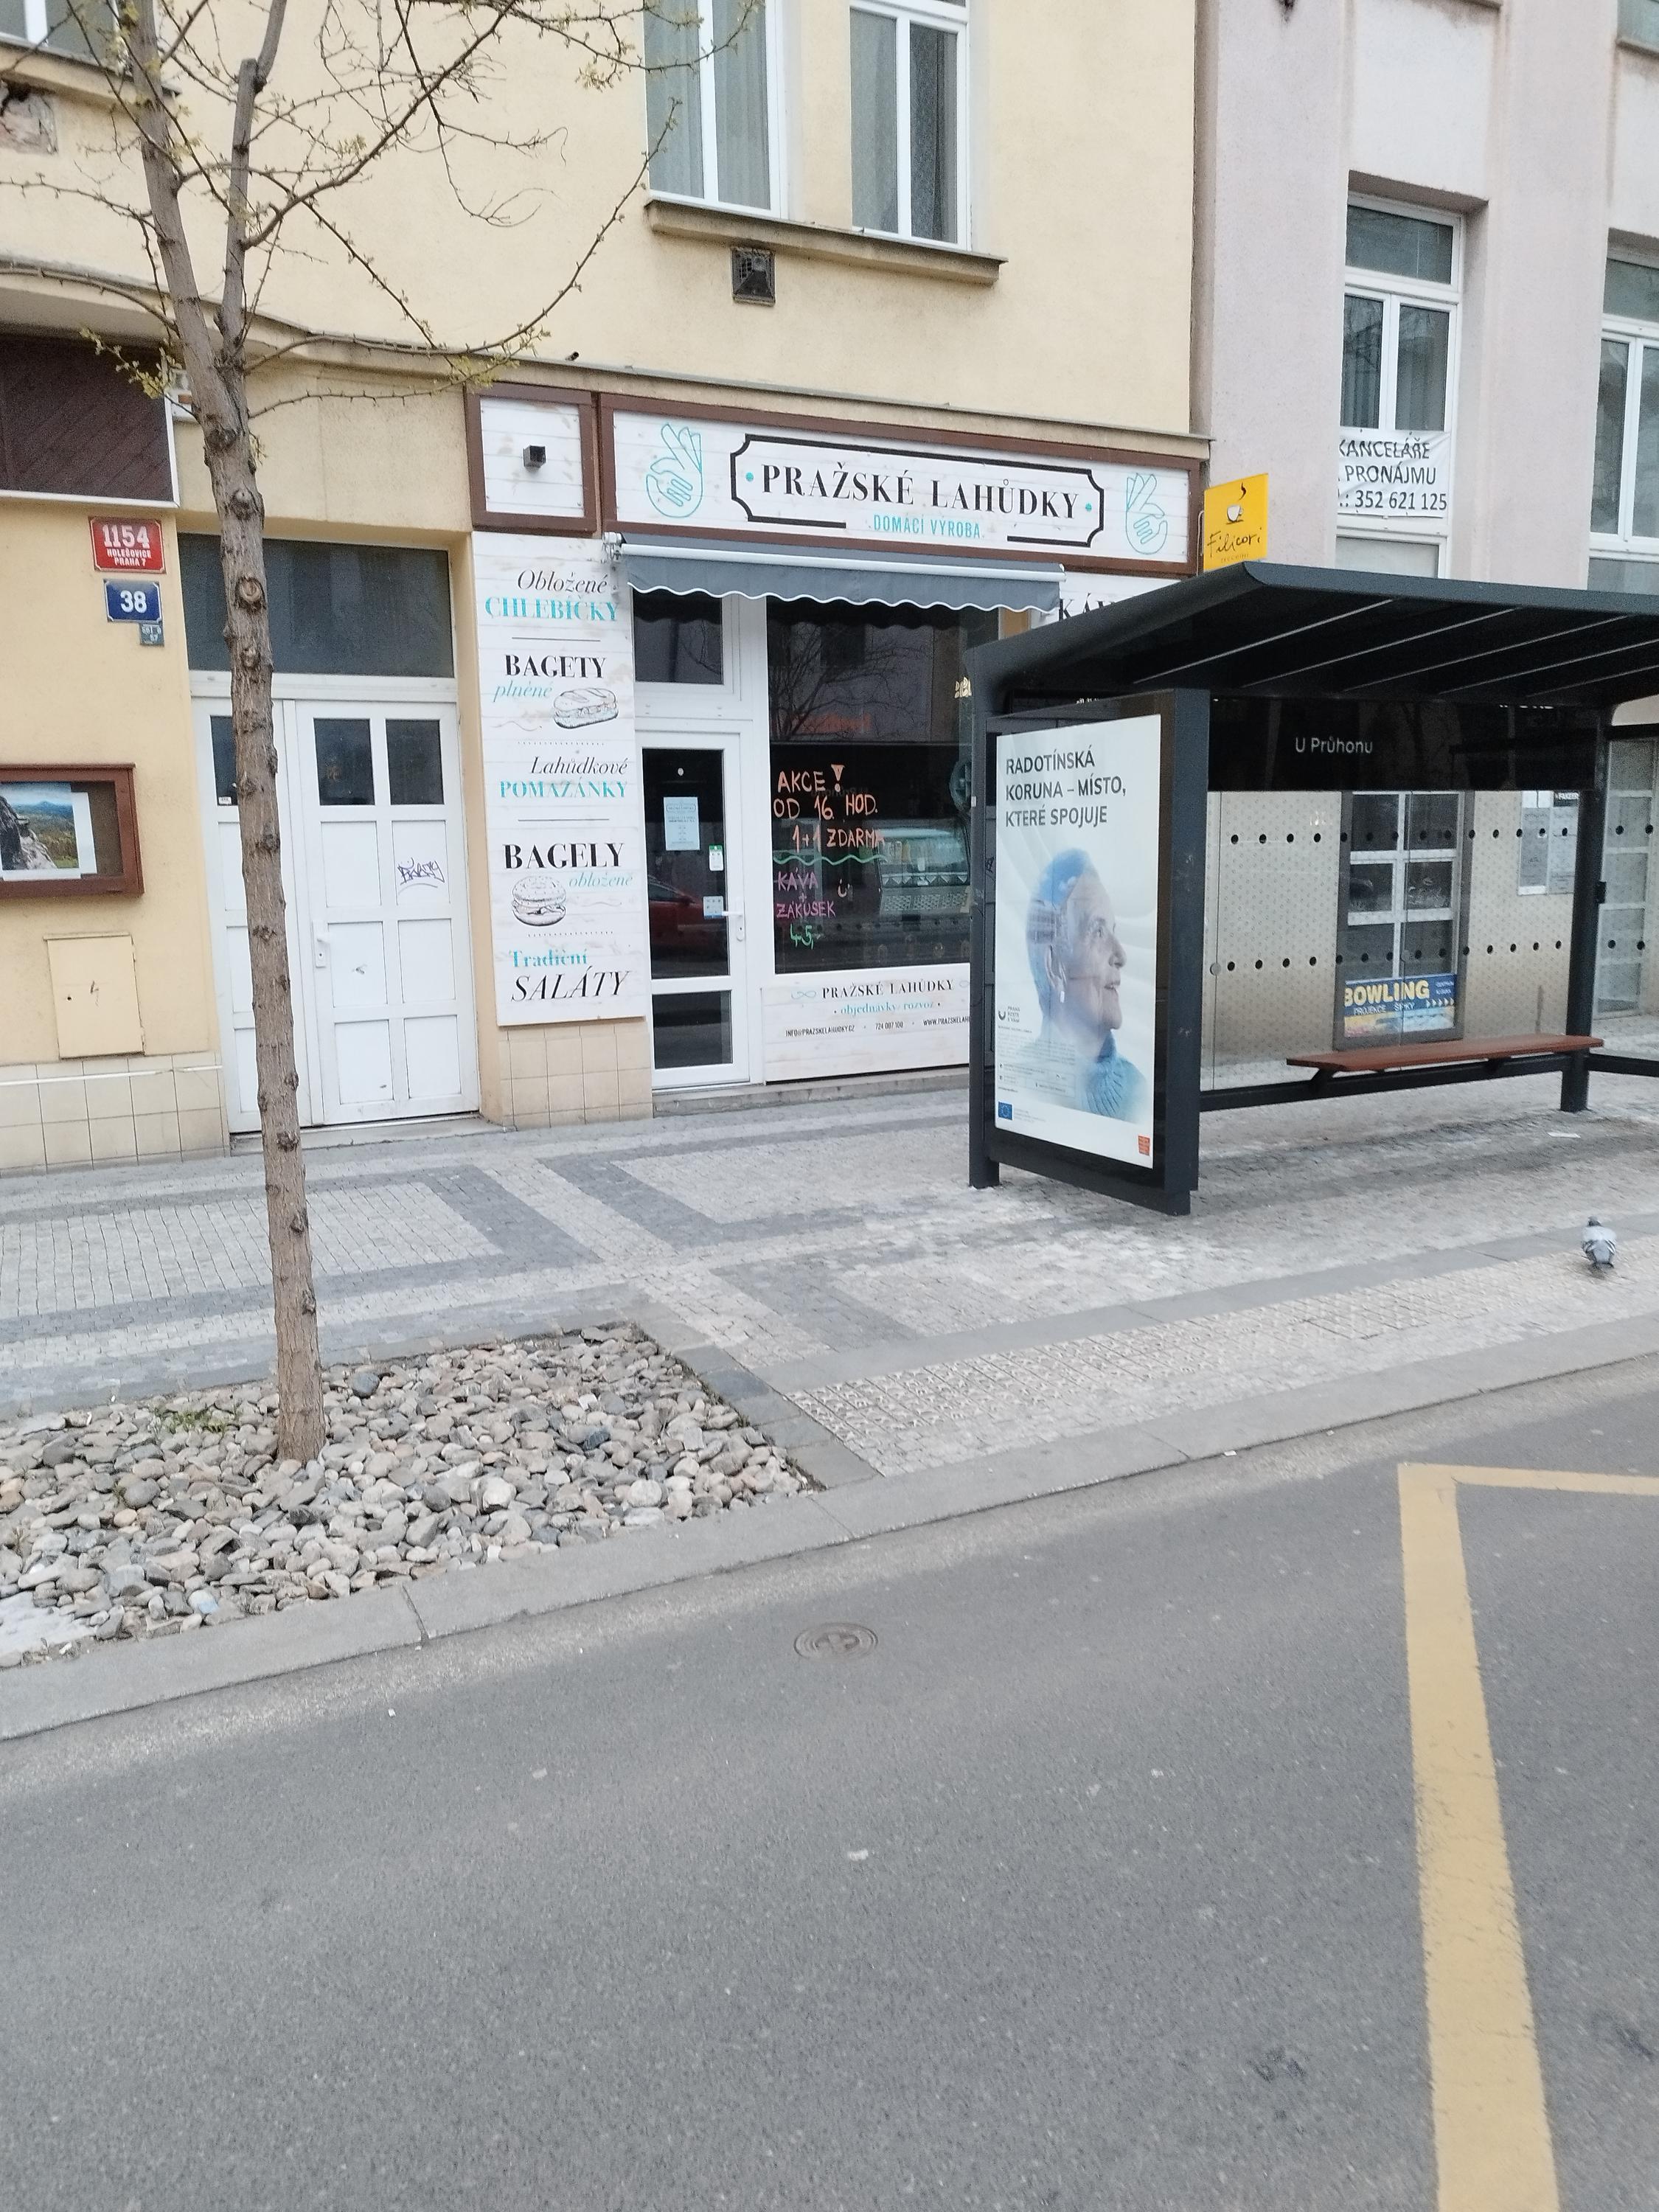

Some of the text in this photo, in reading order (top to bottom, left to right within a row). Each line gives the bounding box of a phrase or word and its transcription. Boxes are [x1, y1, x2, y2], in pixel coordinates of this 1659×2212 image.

[1345, 461, 1436, 484] PRONÁJMU
[762, 462, 1079, 519] PRAŽSKÉ LAHŮDKY
[1354, 490, 1383, 508] 352
[1388, 491, 1415, 509] 621
[1421, 493, 1447, 510] 125
[102, 524, 150, 549] 1154
[874, 512, 980, 539] DOMÁCÍ VÝROBA
[107, 548, 151, 559] HOLEŠOVICE
[1207, 526, 1262, 558] Filicori
[114, 557, 146, 566] PRAHA 7
[518, 569, 608, 594] Obložené
[120, 590, 147, 613] 38
[484, 595, 619, 622] CHLEBÍČKY
[505, 654, 607, 678] BAGETY
[1295, 736, 1373, 754] U Průhonu
[530, 756, 629, 775] Lahůdkové
[1006, 744, 1096, 775] RADOTÍNSKÁ
[499, 776, 627, 798] POMAZÁNKY
[1006, 780, 1063, 801] KORUNA
[1078, 773, 1127, 796] MÍSTO,
[773, 797, 800, 818] OD
[1006, 804, 1107, 828] KTERÉ SPOJUJE
[827, 828, 885, 849] ZDARMA
[502, 842, 625, 869] BAGELY
[568, 872, 633, 887] obložené
[777, 867, 818, 891] KÁVA
[776, 900, 835, 919] ZÁKUSEK
[511, 965, 631, 1002] SALÁTY
[822, 982, 883, 999] PRAŽSKÉ
[1344, 979, 1430, 1007] BOWLING
